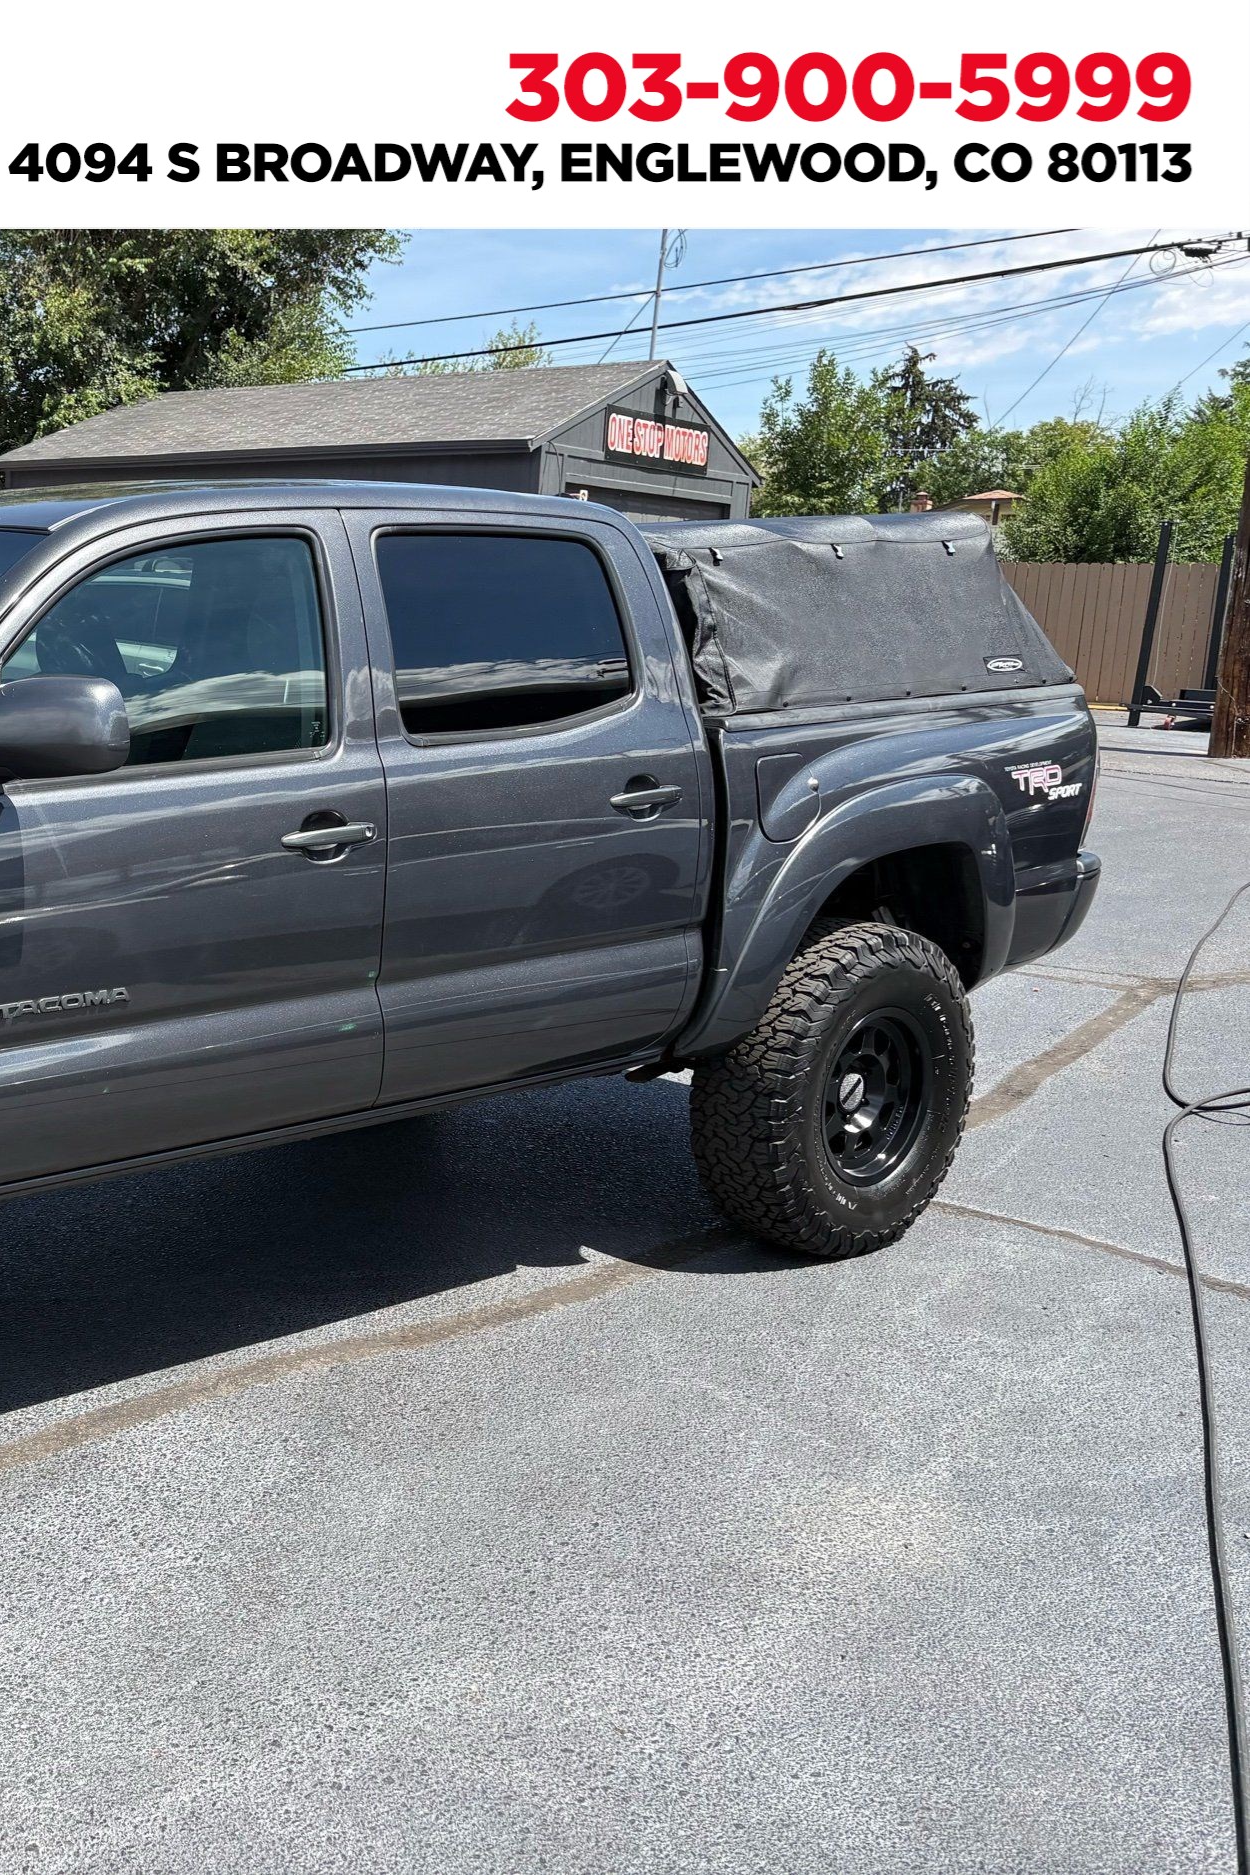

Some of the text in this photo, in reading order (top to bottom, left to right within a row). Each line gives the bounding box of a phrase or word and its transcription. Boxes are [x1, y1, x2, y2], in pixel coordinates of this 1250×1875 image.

[608, 413, 709, 466] ONE STOP MOTORS
[1011, 764, 1062, 796] TRD
[1047, 783, 1083, 800] SPORT
